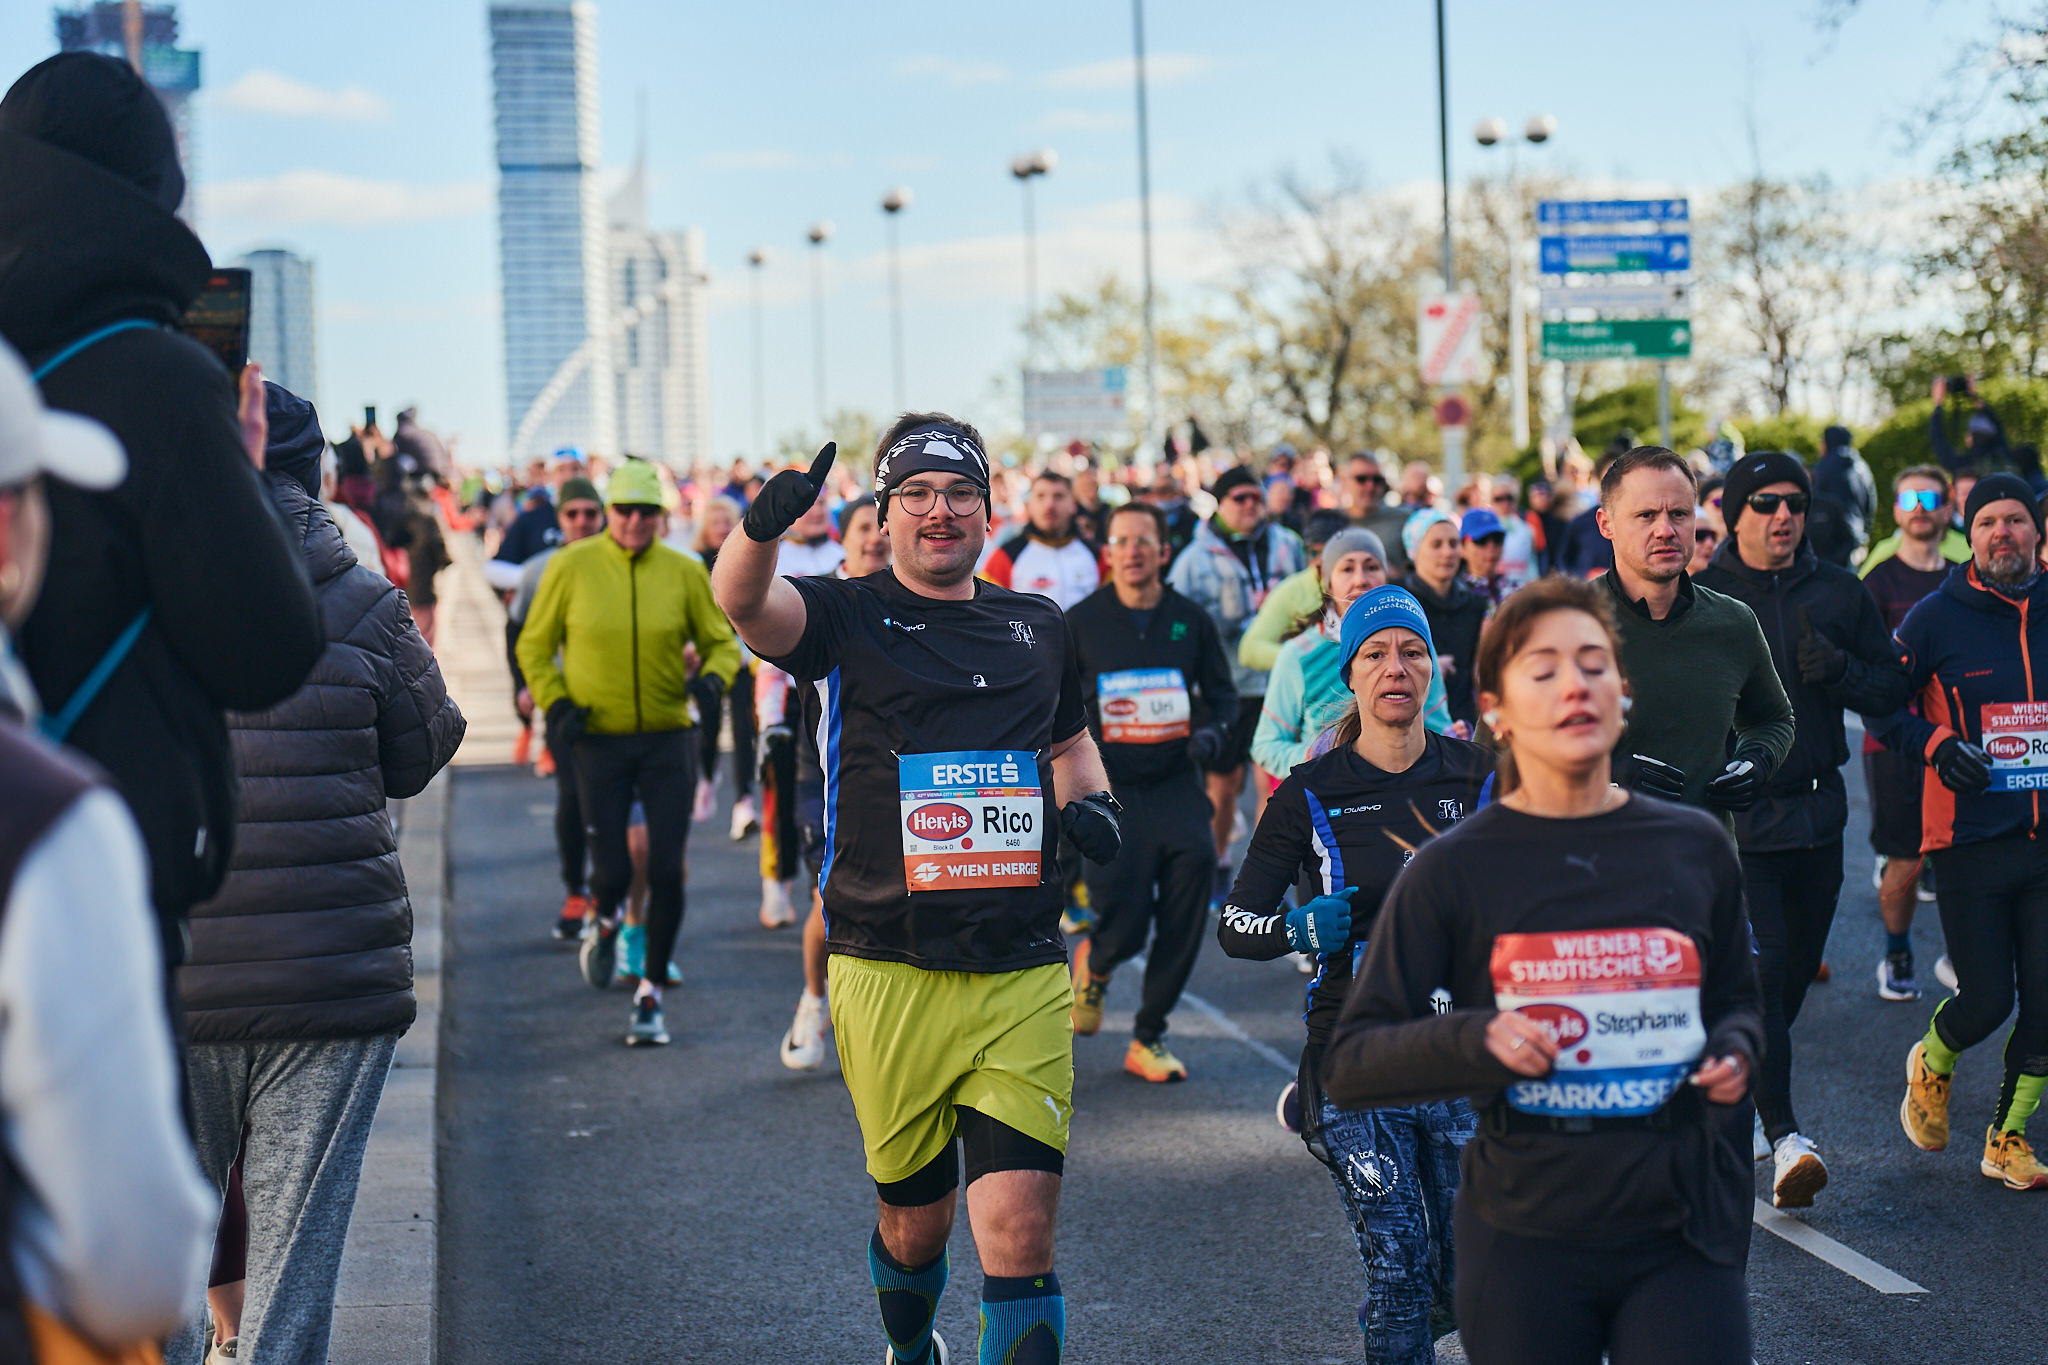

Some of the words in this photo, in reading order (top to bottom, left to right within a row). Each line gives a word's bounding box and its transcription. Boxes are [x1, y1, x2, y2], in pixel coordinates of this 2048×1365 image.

[1990, 740, 2027, 756] Hervis
[932, 763, 999, 786] ERSTE
[913, 812, 968, 833] Hervis
[982, 805, 1033, 834] Rico
[946, 863, 989, 878] WIEN
[992, 862, 1038, 876] ENERGIE
[1553, 933, 1643, 959] WIENER
[1596, 1010, 1689, 1037] Stephanie
[1515, 1078, 1671, 1110] SPARKASSE
[1379, 1153, 1395, 1166] NEW
[1347, 1165, 1374, 1198] MARATHON
[1391, 1166, 1399, 1185] YORK
[1376, 1185, 1393, 1197] CITY
